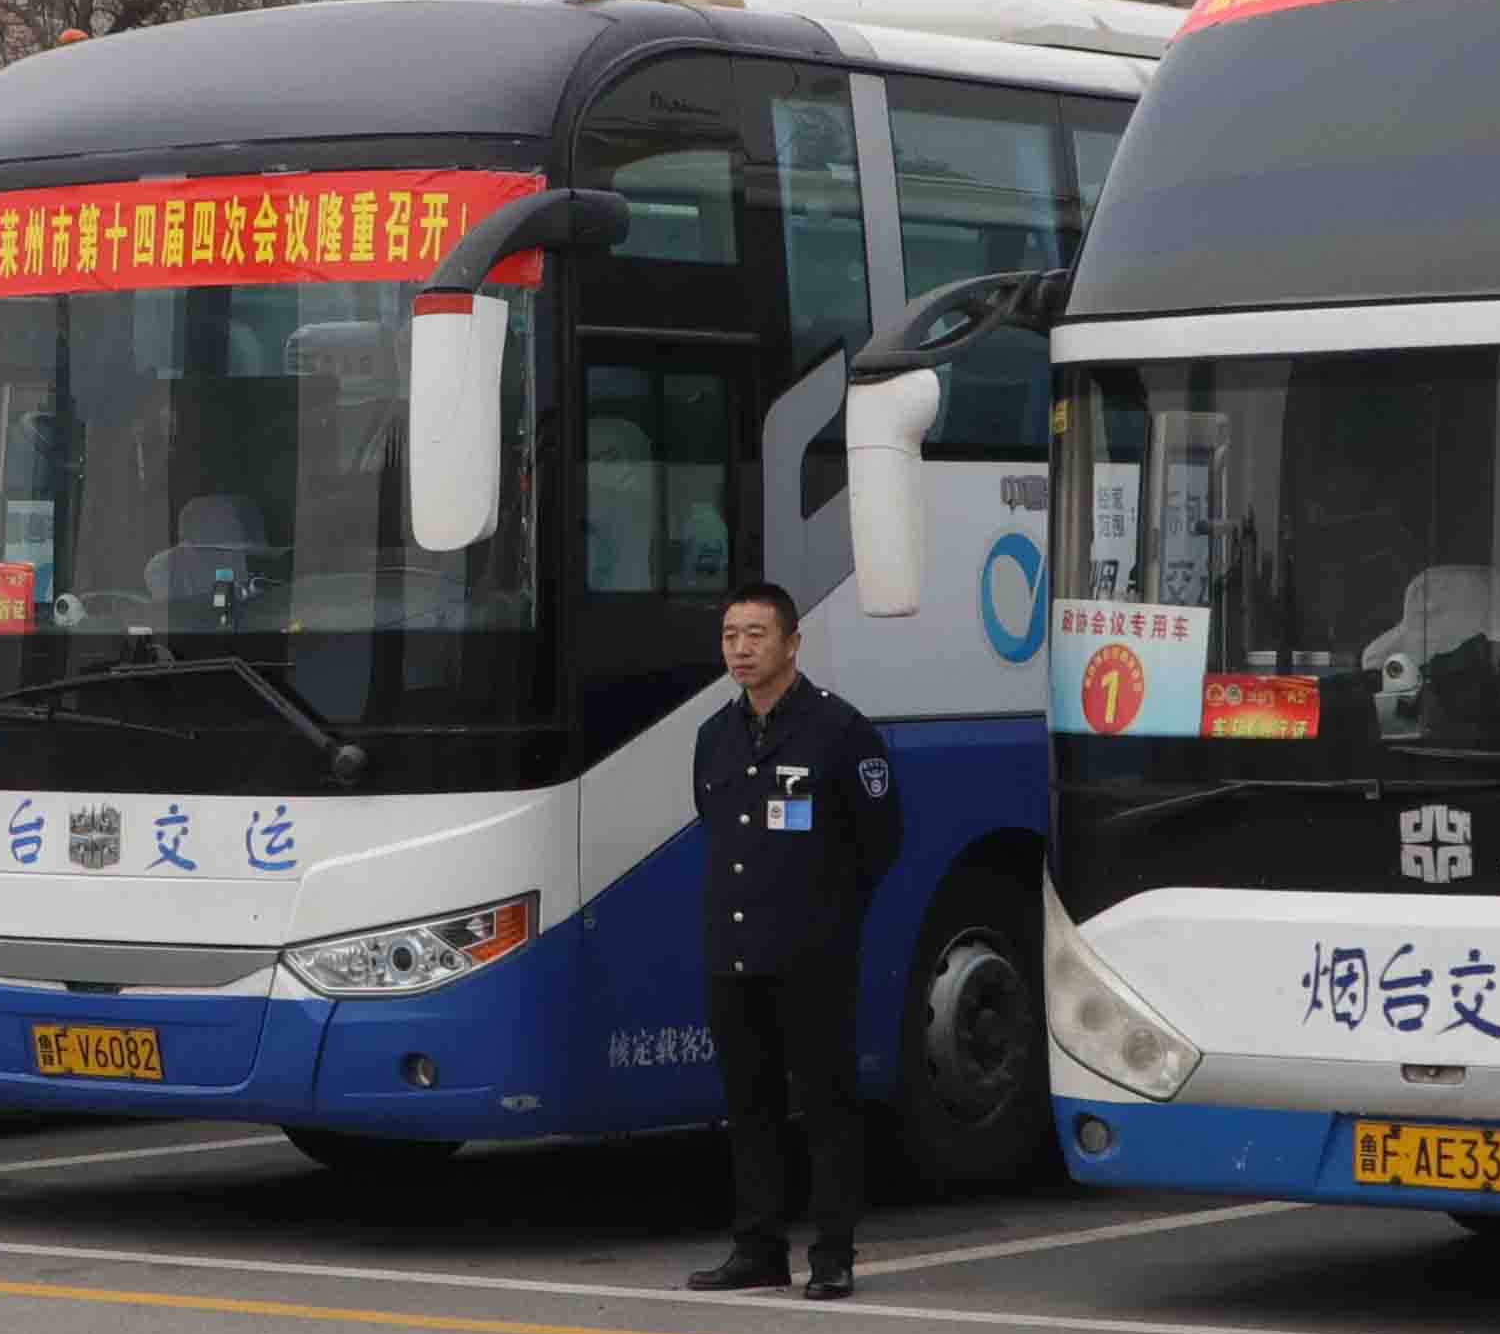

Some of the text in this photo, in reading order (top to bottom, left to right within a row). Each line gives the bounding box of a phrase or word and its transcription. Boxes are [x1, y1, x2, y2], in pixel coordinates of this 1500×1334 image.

[1062, 609, 1190, 641] 政协会议专用车
[1101, 669, 1121, 724] 1
